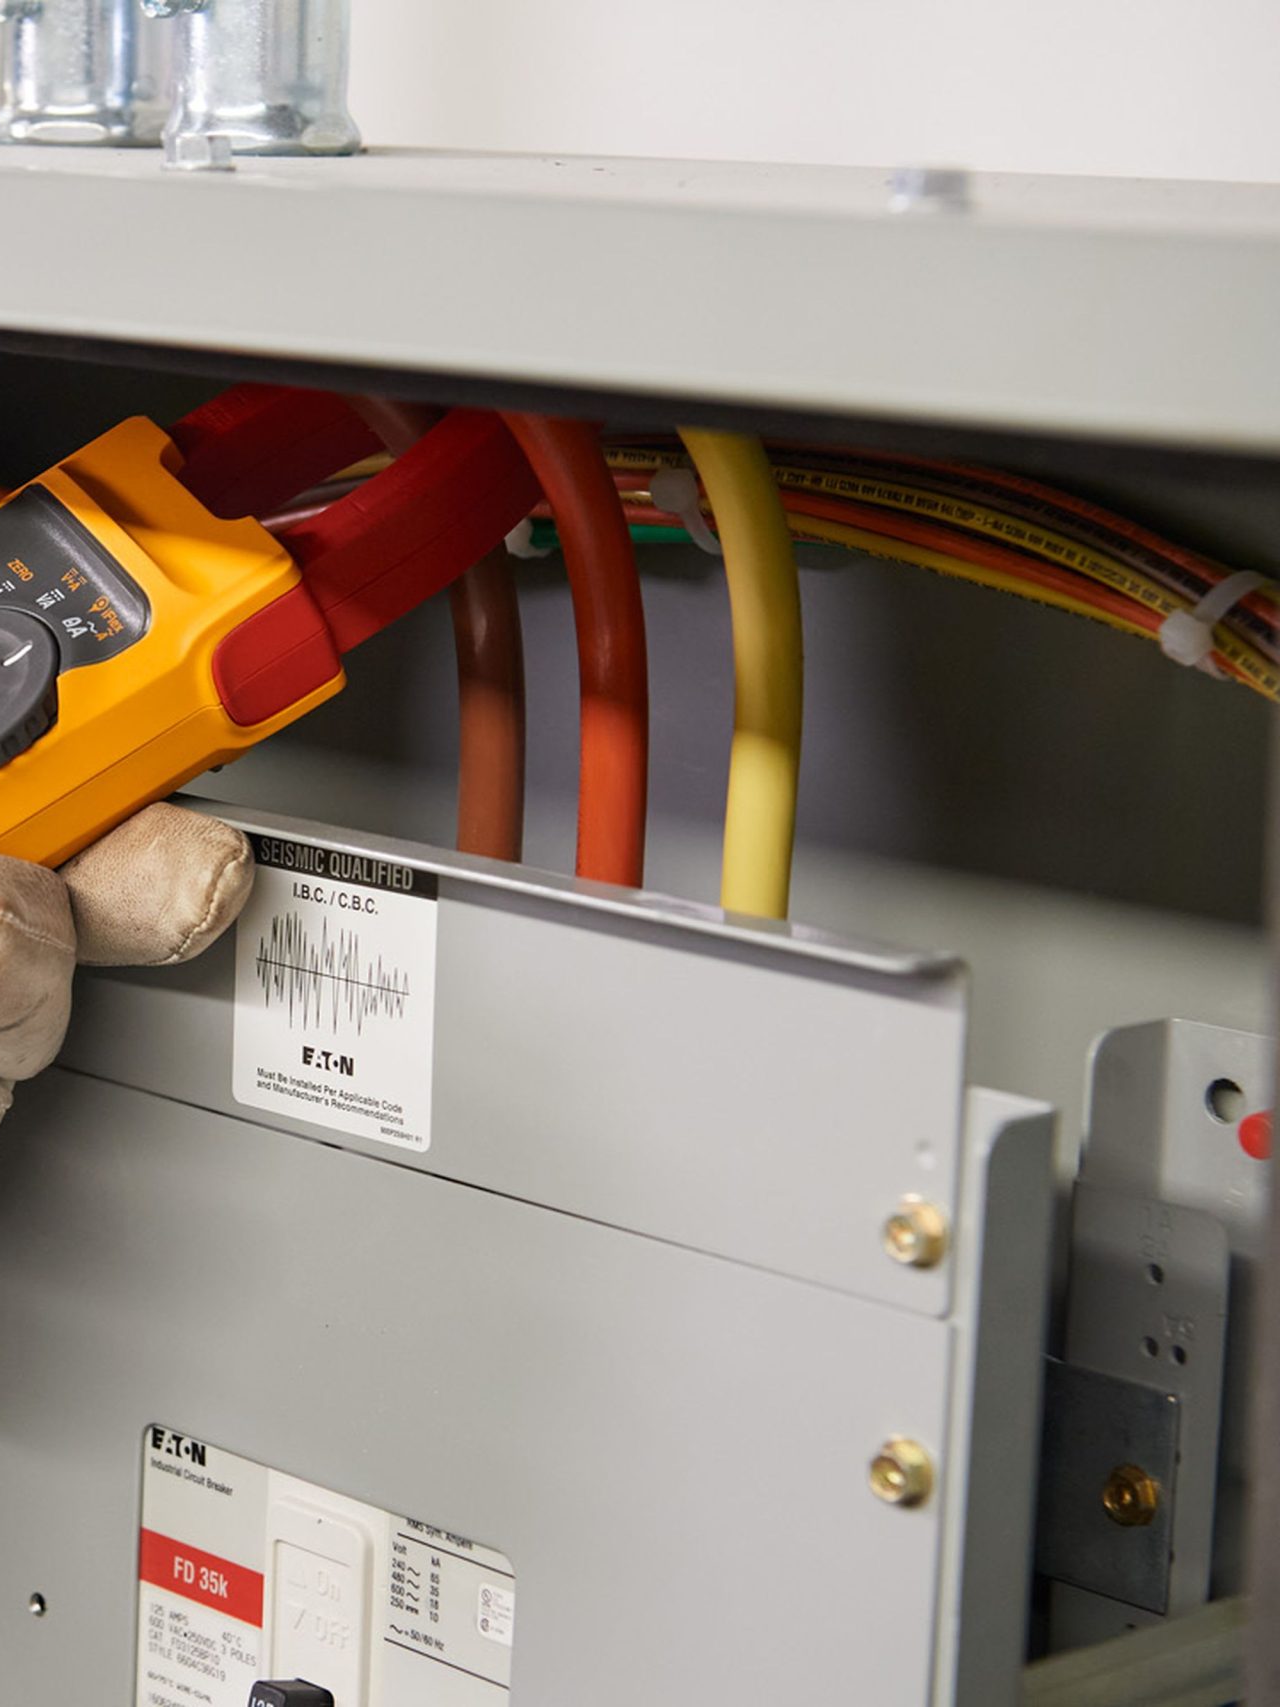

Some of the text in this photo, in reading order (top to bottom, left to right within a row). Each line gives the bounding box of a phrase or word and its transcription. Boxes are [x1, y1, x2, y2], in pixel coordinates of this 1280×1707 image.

[6, 558, 36, 583] ZERO
[261, 837, 414, 891] SEISMIC QUALIFIED
[293, 881, 328, 905] I.B.C.
[338, 892, 379, 915] C.B.C.
[256, 1067, 403, 1114] Must Be Installed Per Applicable Code
[256, 1080, 405, 1126] and Manufacturer's Recommendations
[150, 1456, 234, 1496] Industrial Circuit Breaker
[392, 1541, 408, 1556] Volt
[173, 1555, 229, 1599] FD 35k
[391, 1557, 407, 1572] 240
[391, 1571, 406, 1584] 480
[390, 1595, 440, 1624] 250 10
[230, 1647, 258, 1667] POLES
